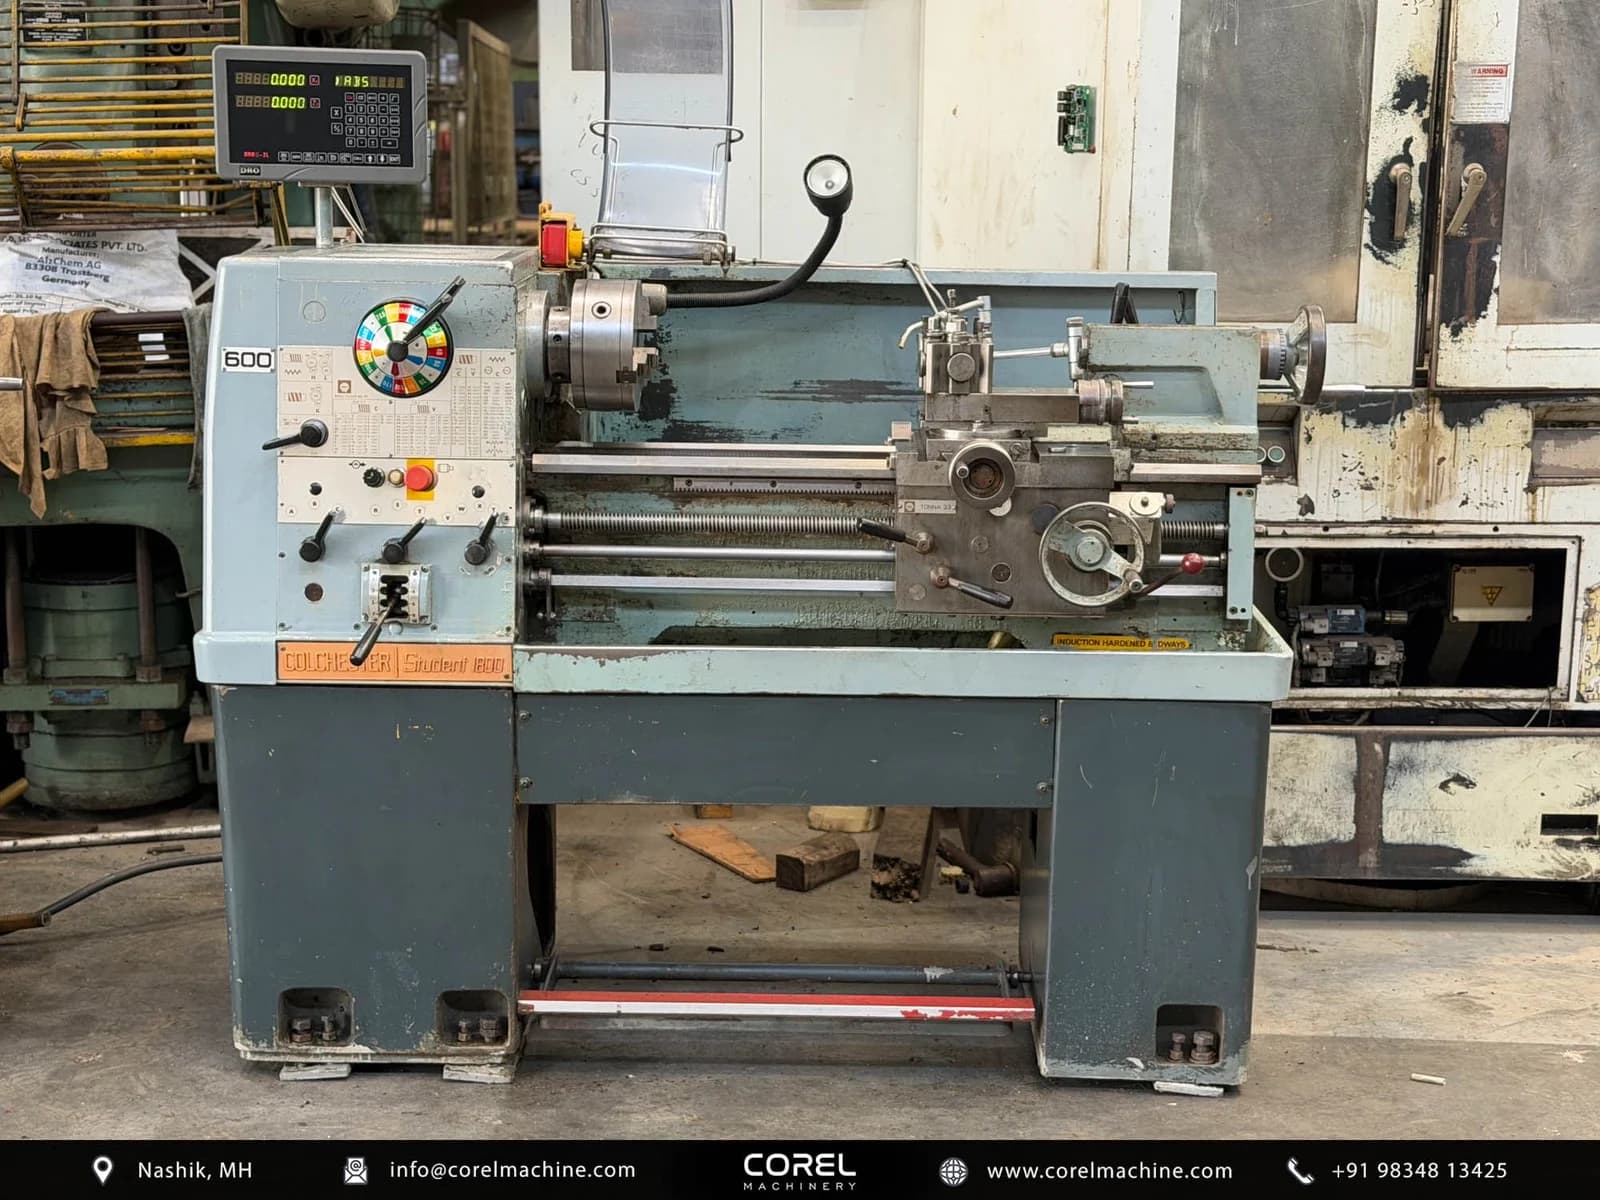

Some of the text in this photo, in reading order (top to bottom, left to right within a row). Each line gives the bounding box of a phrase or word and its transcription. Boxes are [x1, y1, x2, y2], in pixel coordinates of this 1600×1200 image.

[86, 260, 102, 270] AG
[225, 351, 271, 368] 600
[1056, 638, 1100, 647] INDUCTION
[284, 652, 390, 672] COLCHEER
[404, 653, 504, 673] Student 1800
